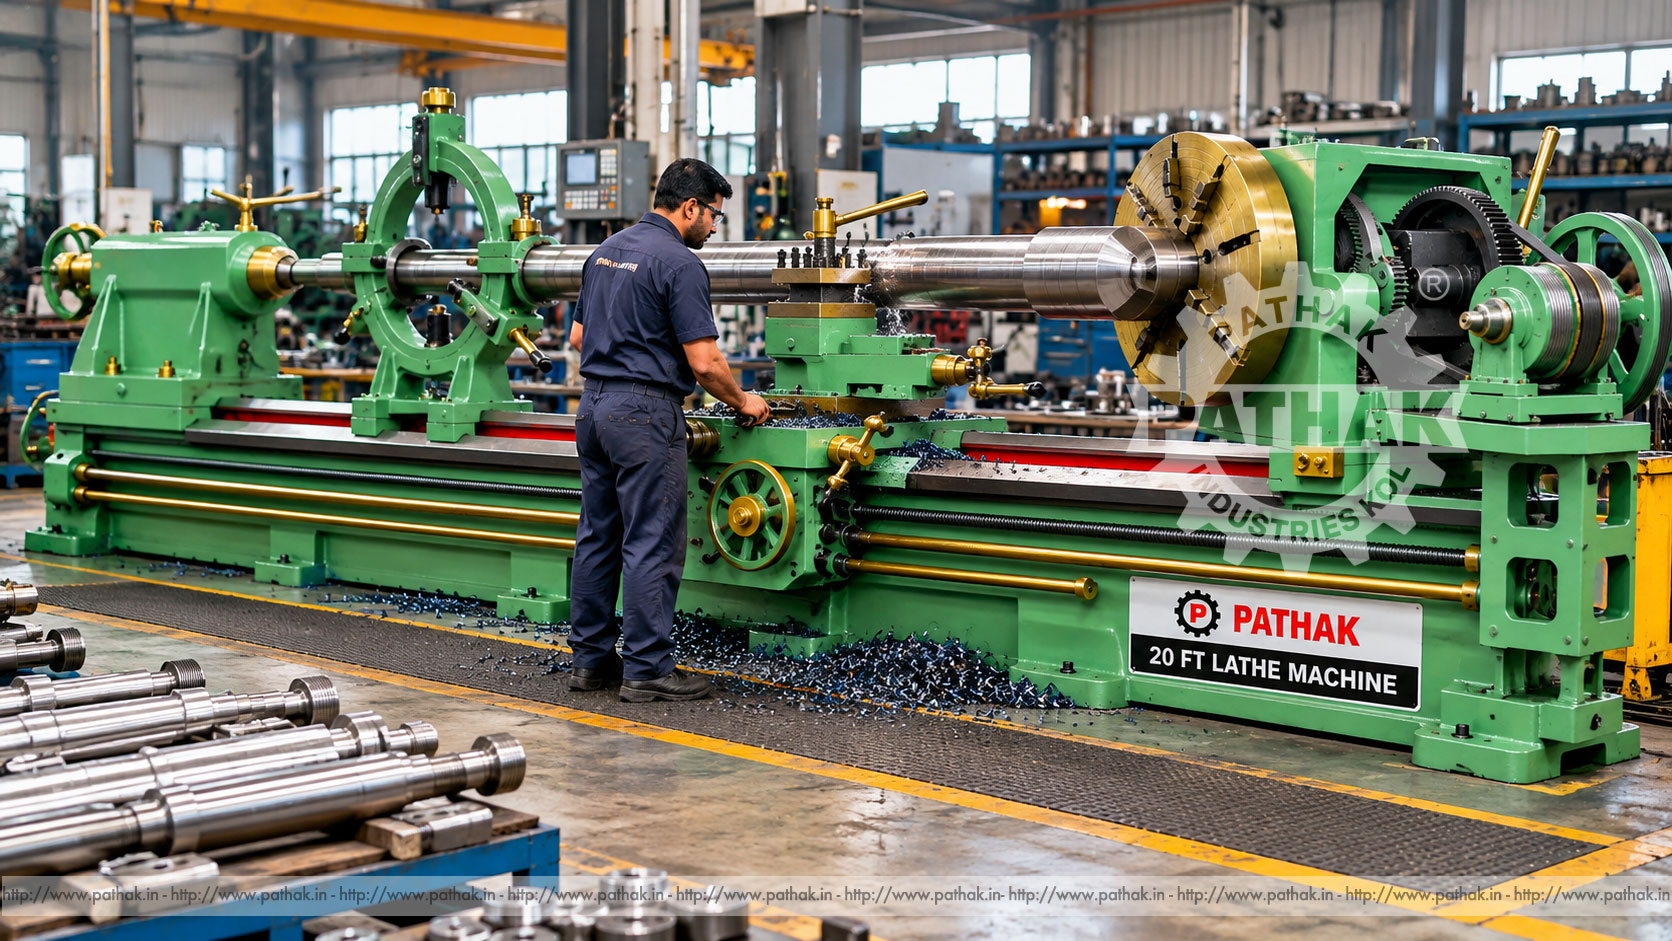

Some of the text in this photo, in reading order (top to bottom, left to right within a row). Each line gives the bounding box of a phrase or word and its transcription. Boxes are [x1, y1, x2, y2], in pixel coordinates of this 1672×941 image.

[1190, 603, 1360, 646] P PATHAK
[1149, 646, 1397, 695] 20 FT LATHE MACHINE
